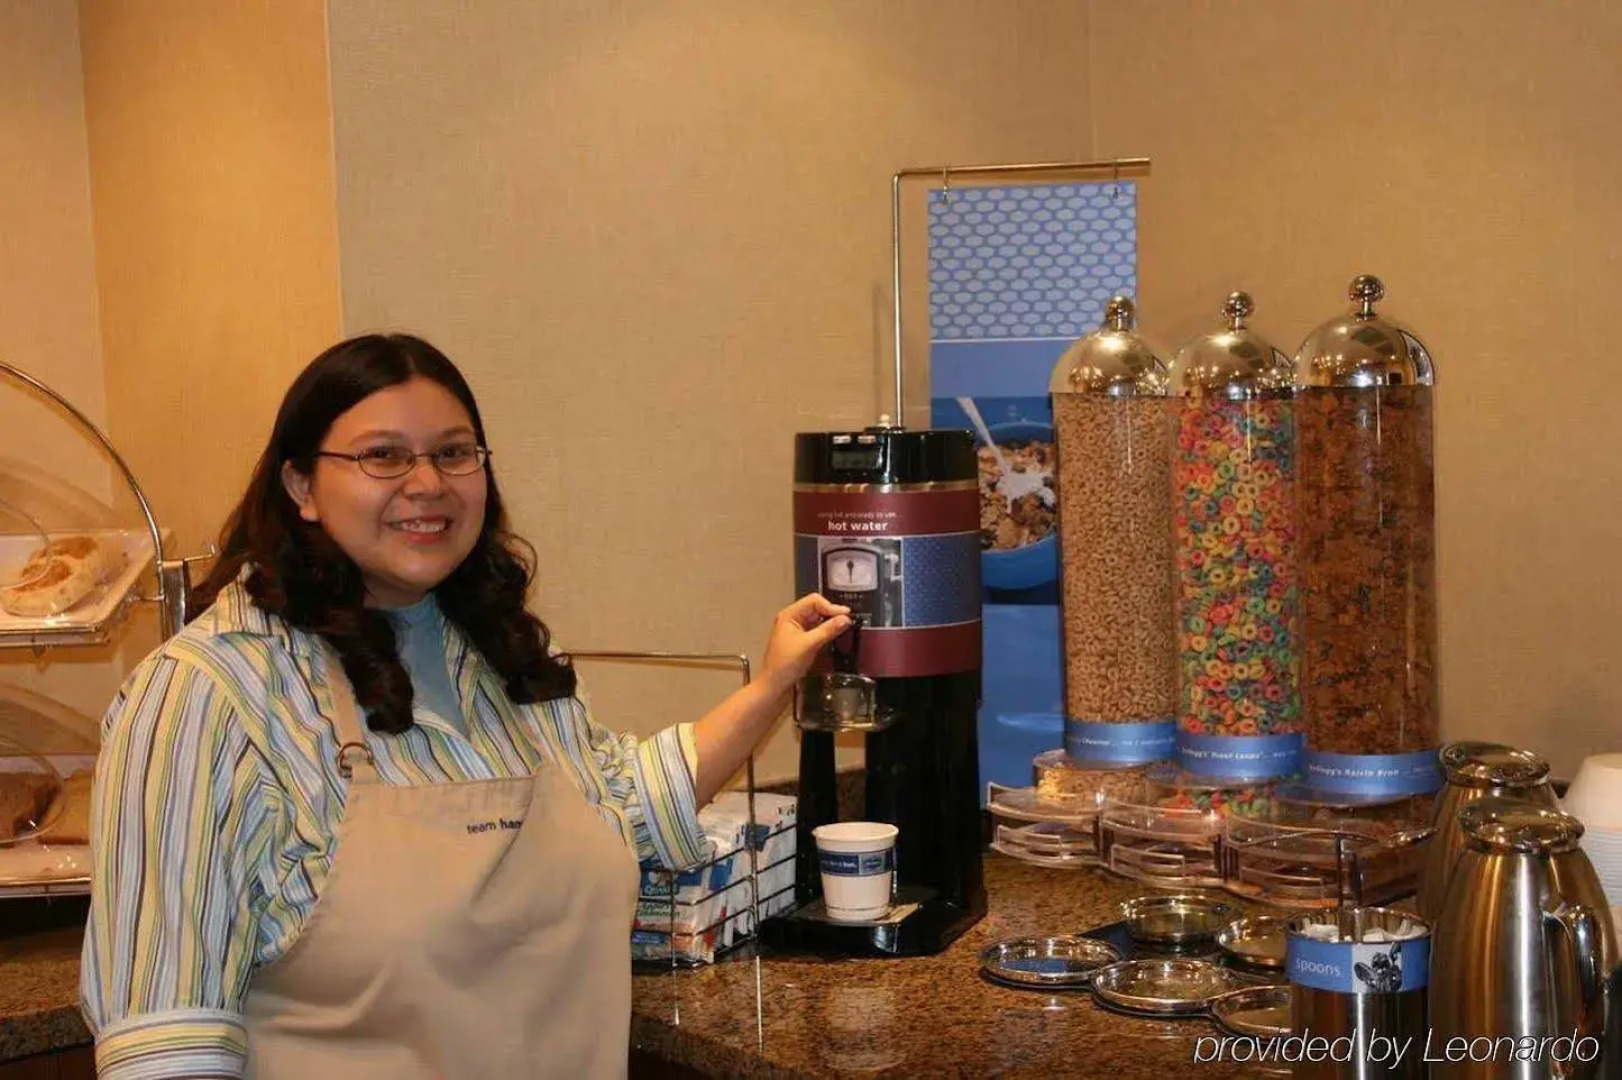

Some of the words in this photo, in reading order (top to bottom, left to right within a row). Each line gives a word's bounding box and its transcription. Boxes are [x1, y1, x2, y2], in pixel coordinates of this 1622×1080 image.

[828, 521, 847, 531] hot
[850, 521, 888, 531] water
[466, 821, 496, 835] team
[1296, 957, 1341, 977] spoons
